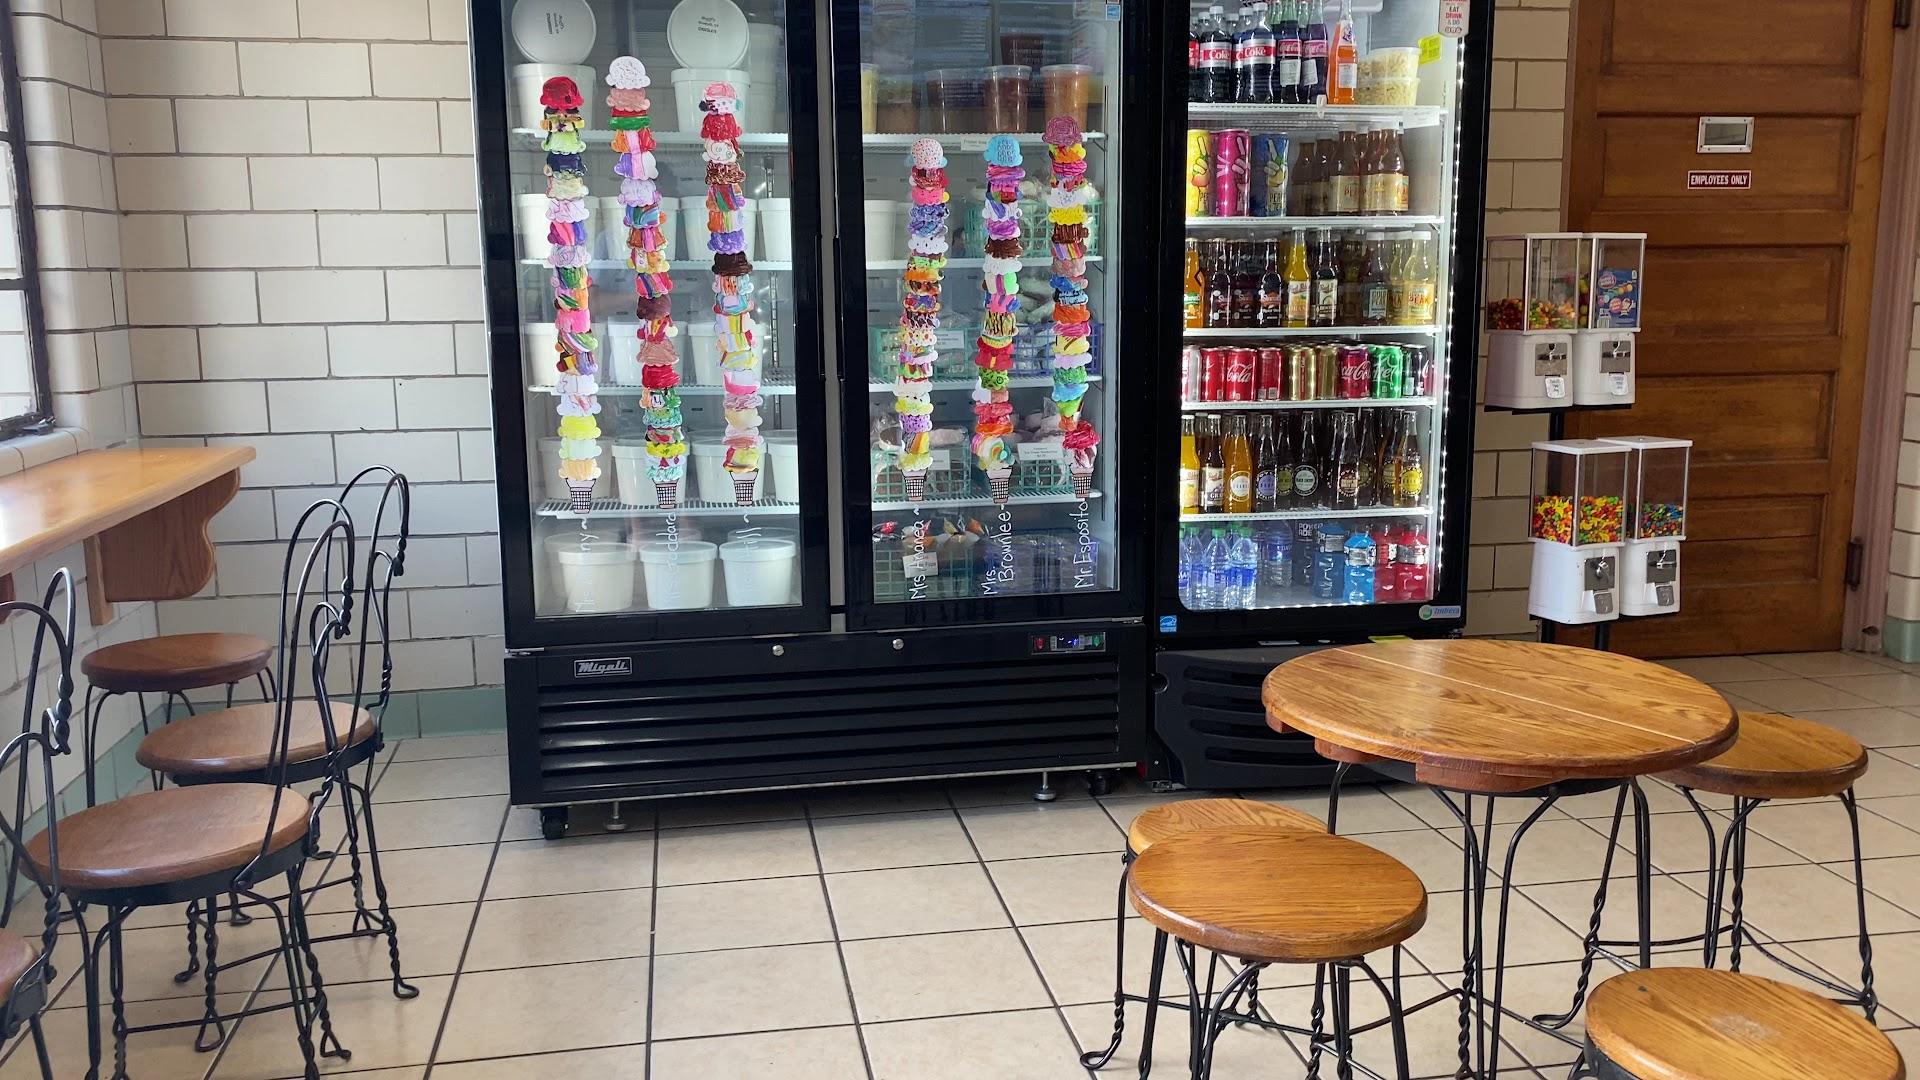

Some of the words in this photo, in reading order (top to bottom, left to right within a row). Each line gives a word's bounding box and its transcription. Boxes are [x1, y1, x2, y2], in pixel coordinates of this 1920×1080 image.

[1209, 48, 1230, 60] Coke
[1244, 46, 1266, 57] Coke
[1690, 174, 1729, 185] EMPLOYEES
[1731, 174, 1748, 185] ONLY
[1069, 501, 1098, 565] Esposito
[990, 511, 1014, 582] Brownlee
[981, 566, 998, 595] Mrs.
[1073, 565, 1095, 589] Mr.
[578, 660, 628, 674] Migali
